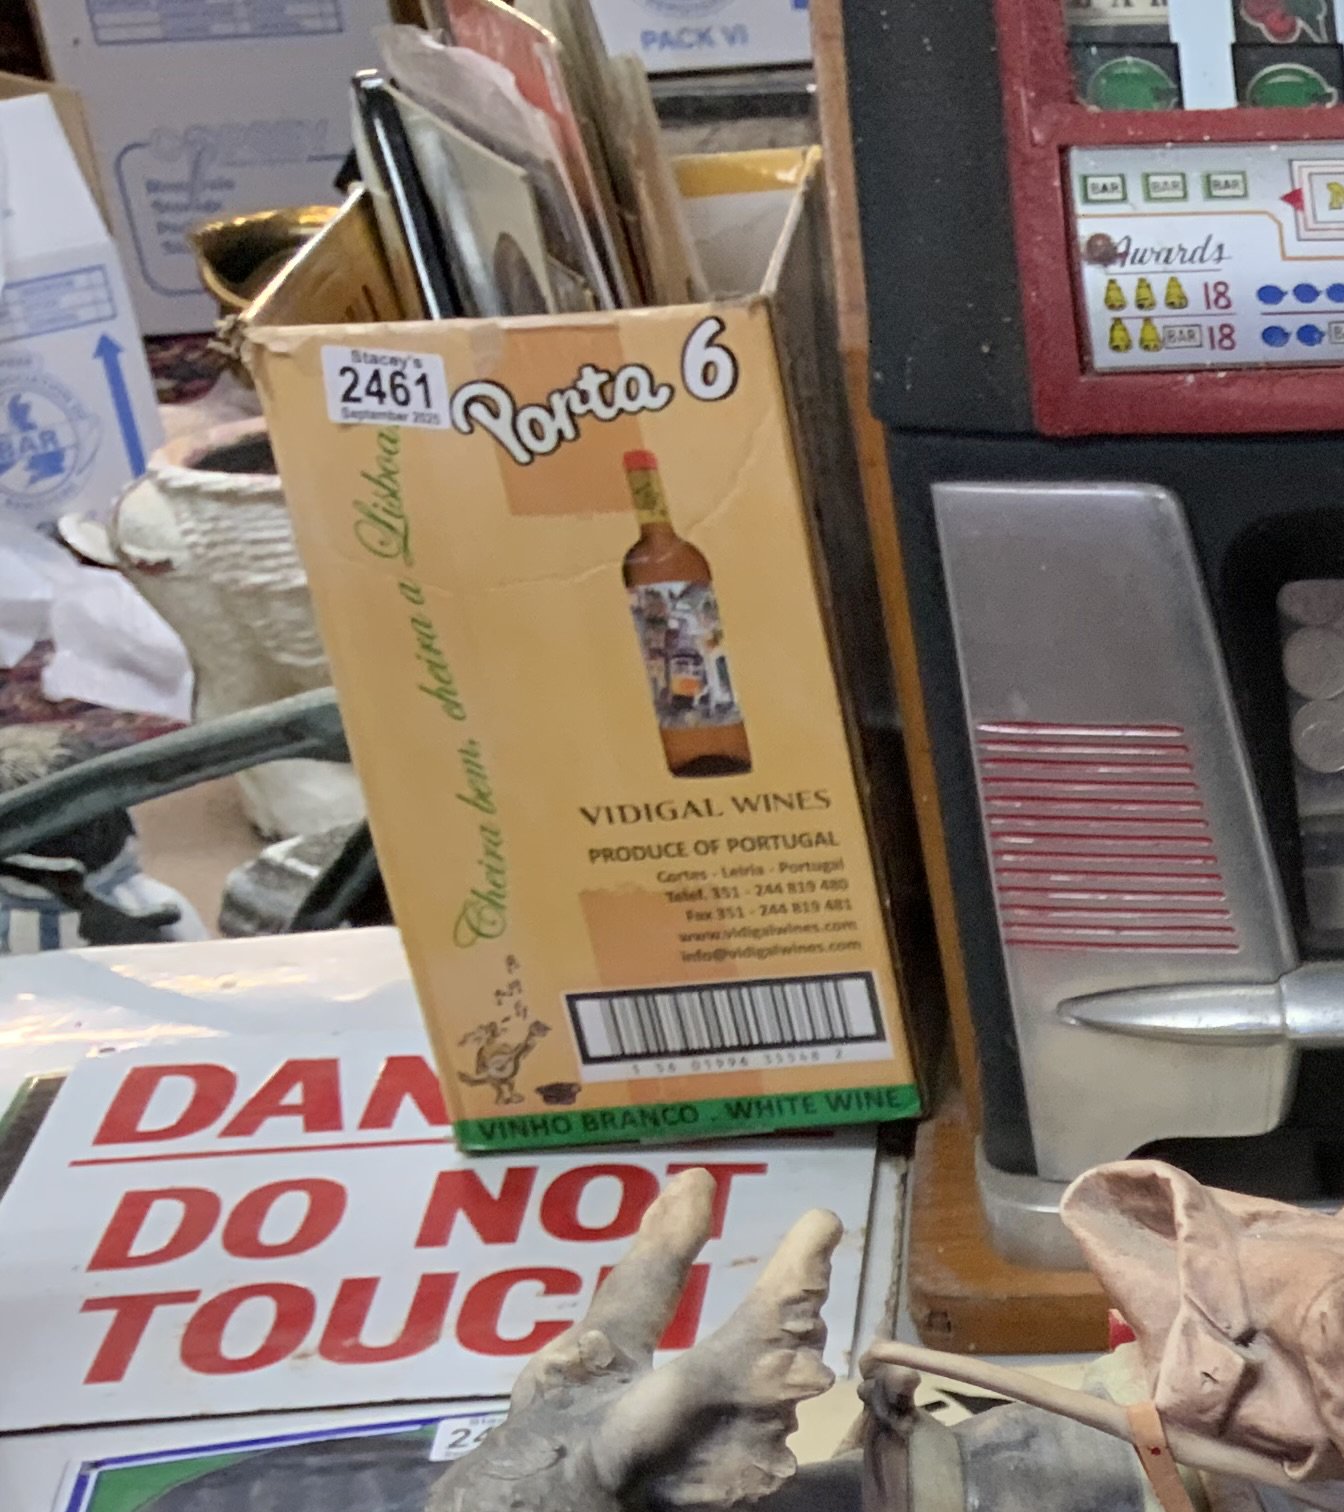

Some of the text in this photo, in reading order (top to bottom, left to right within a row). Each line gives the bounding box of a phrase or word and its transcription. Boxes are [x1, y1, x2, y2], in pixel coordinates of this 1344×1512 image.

[640, 27, 715, 49] PACK
[1090, 182, 1121, 195] BAR
[1151, 180, 1181, 193] BAR
[1211, 178, 1241, 191] BAR
[1112, 233, 1232, 267] Awards
[1203, 280, 1232, 311] 18
[1166, 323, 1237, 351] BAR 18
[351, 349, 423, 371] Stacey's
[339, 365, 432, 409] 2461
[449, 315, 740, 466] Porta 6
[579, 788, 832, 827] VIDIGAL WINES
[587, 830, 840, 865] PRODUCE OF PORTUGAL
[778, 856, 845, 876] Portugal
[711, 885, 741, 900] 351
[754, 881, 784, 898] 244
[787, 879, 817, 894] 819
[684, 897, 853, 922] Fax 351 244 819 481
[678, 919, 859, 944] www.vidigalwines.com
[680, 938, 862, 963] info@vidigalwines.com
[92, 1055, 450, 1147] DAN
[477, 1087, 902, 1142] VINHO BRANCO WHITE WINE
[84, 1162, 768, 1274] DO NOT
